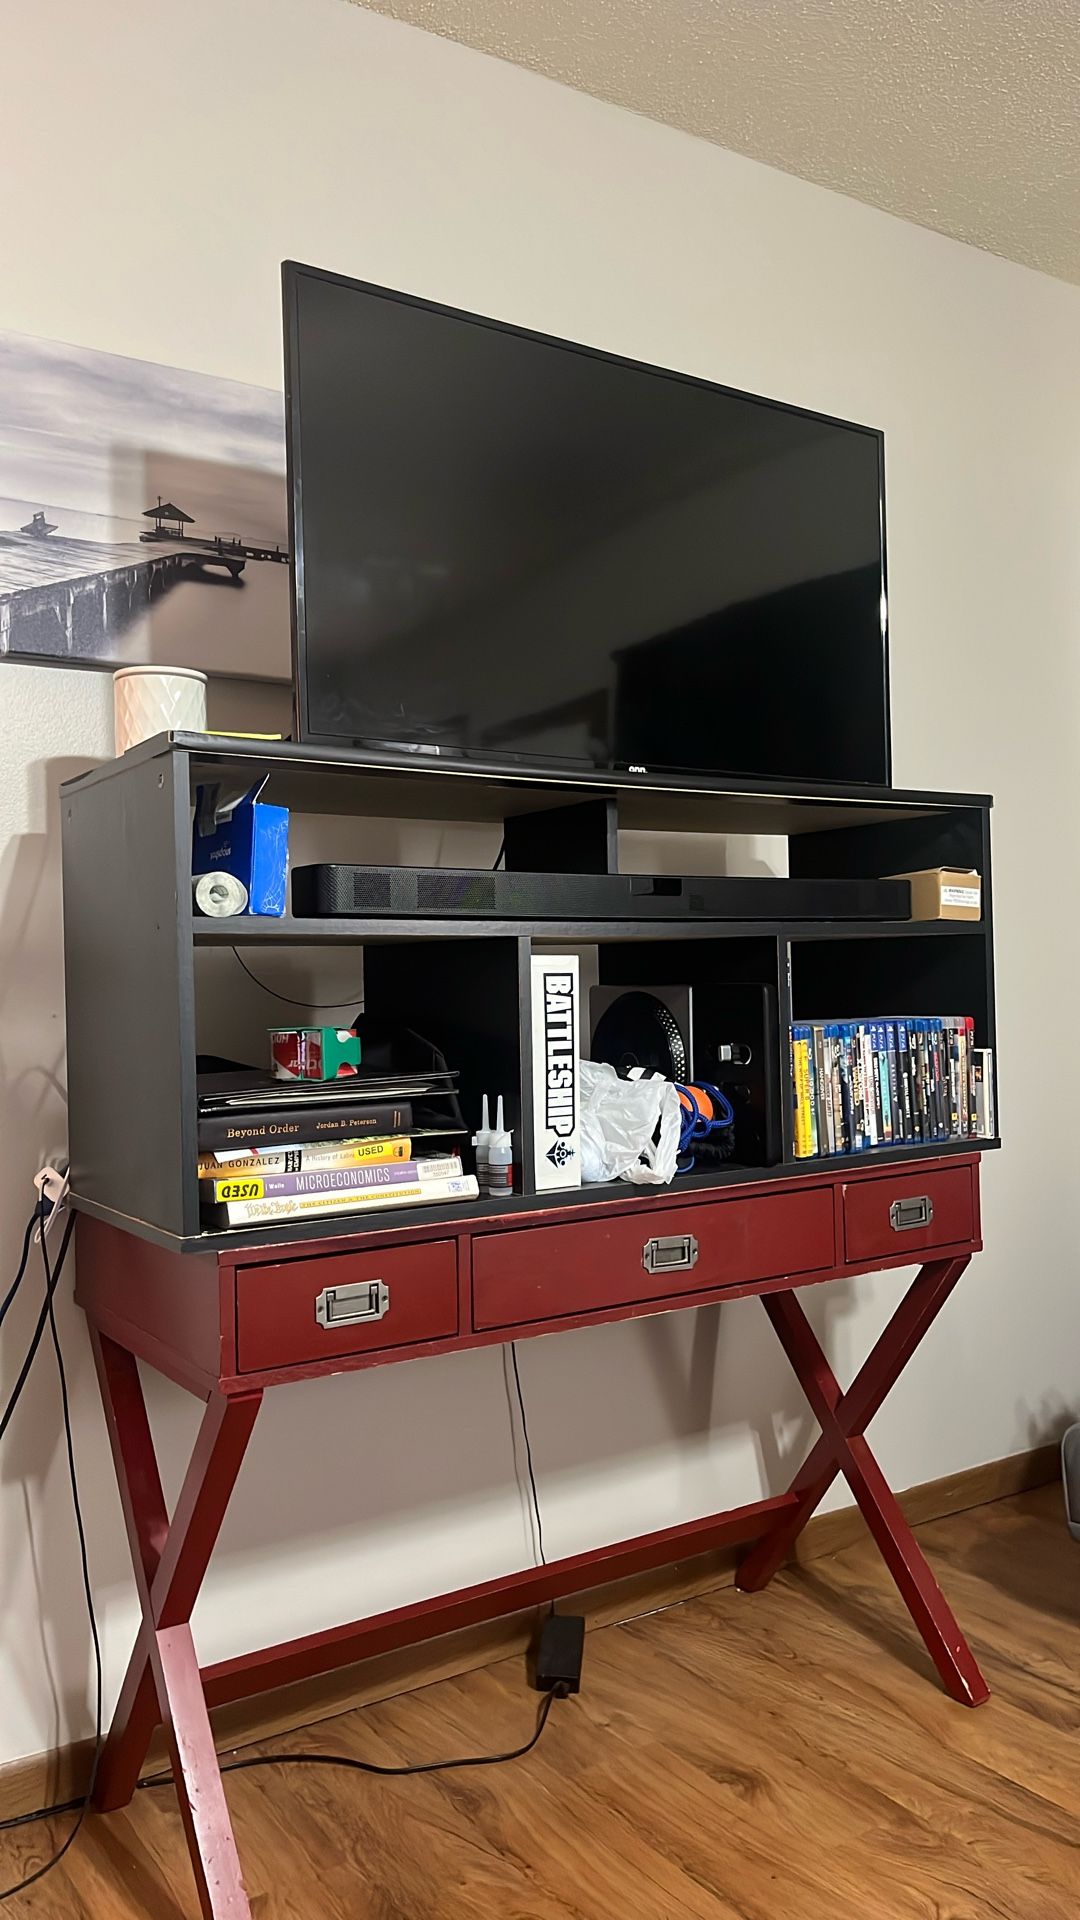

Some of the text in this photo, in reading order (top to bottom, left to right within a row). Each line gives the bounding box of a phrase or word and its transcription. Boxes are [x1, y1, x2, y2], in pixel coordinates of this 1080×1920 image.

[544, 973, 575, 1137] BATTLESHIP
[227, 1123, 300, 1138] Beyond Order
[316, 1118, 377, 1130] Jordan B. Peterson
[358, 1145, 384, 1157] USED
[199, 1157, 280, 1170] JUAN GONZALEZ
[296, 1168, 390, 1191] MICROECONOMICS
[221, 1184, 259, 1198] USED
